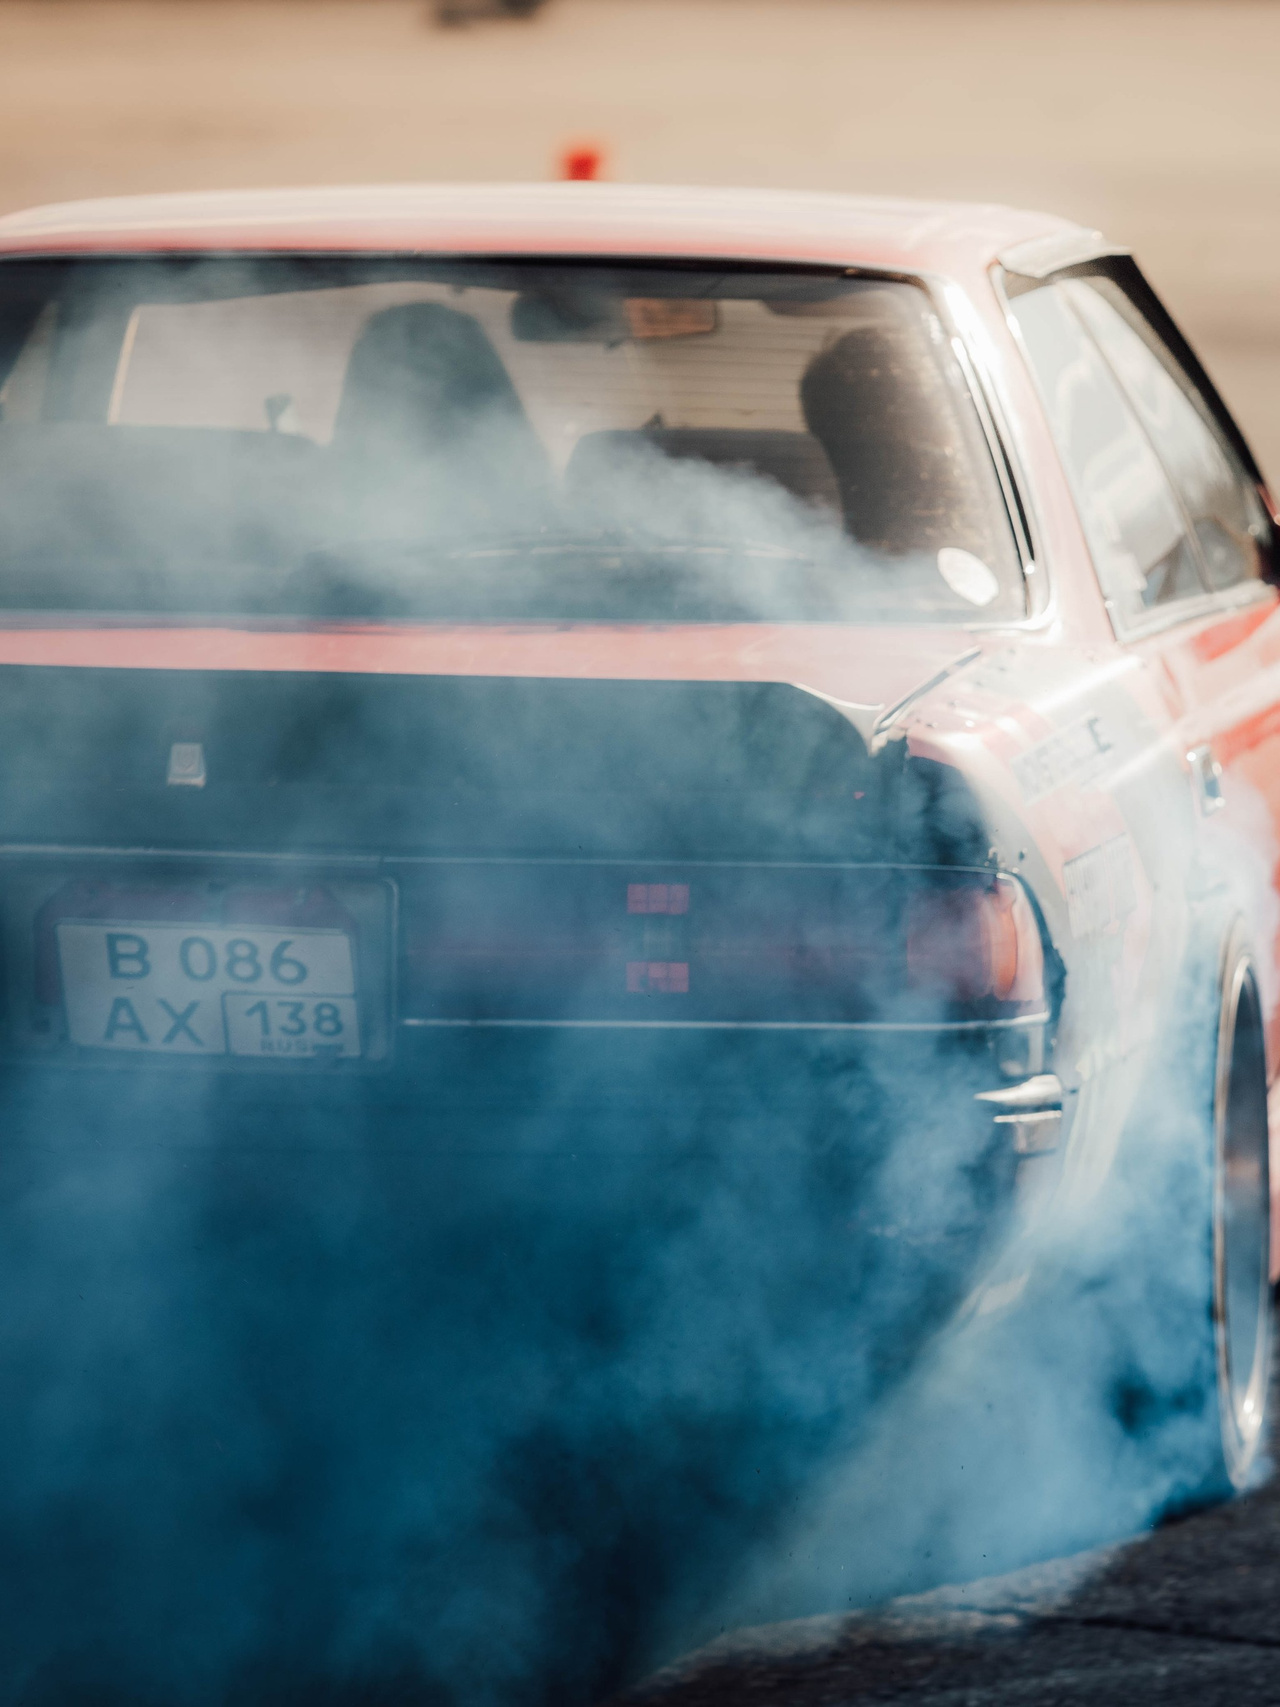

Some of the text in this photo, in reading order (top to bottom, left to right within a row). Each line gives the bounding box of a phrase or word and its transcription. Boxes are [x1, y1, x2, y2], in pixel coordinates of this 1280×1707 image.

[105, 932, 309, 985] B 086
[103, 997, 344, 1046] AX 138
